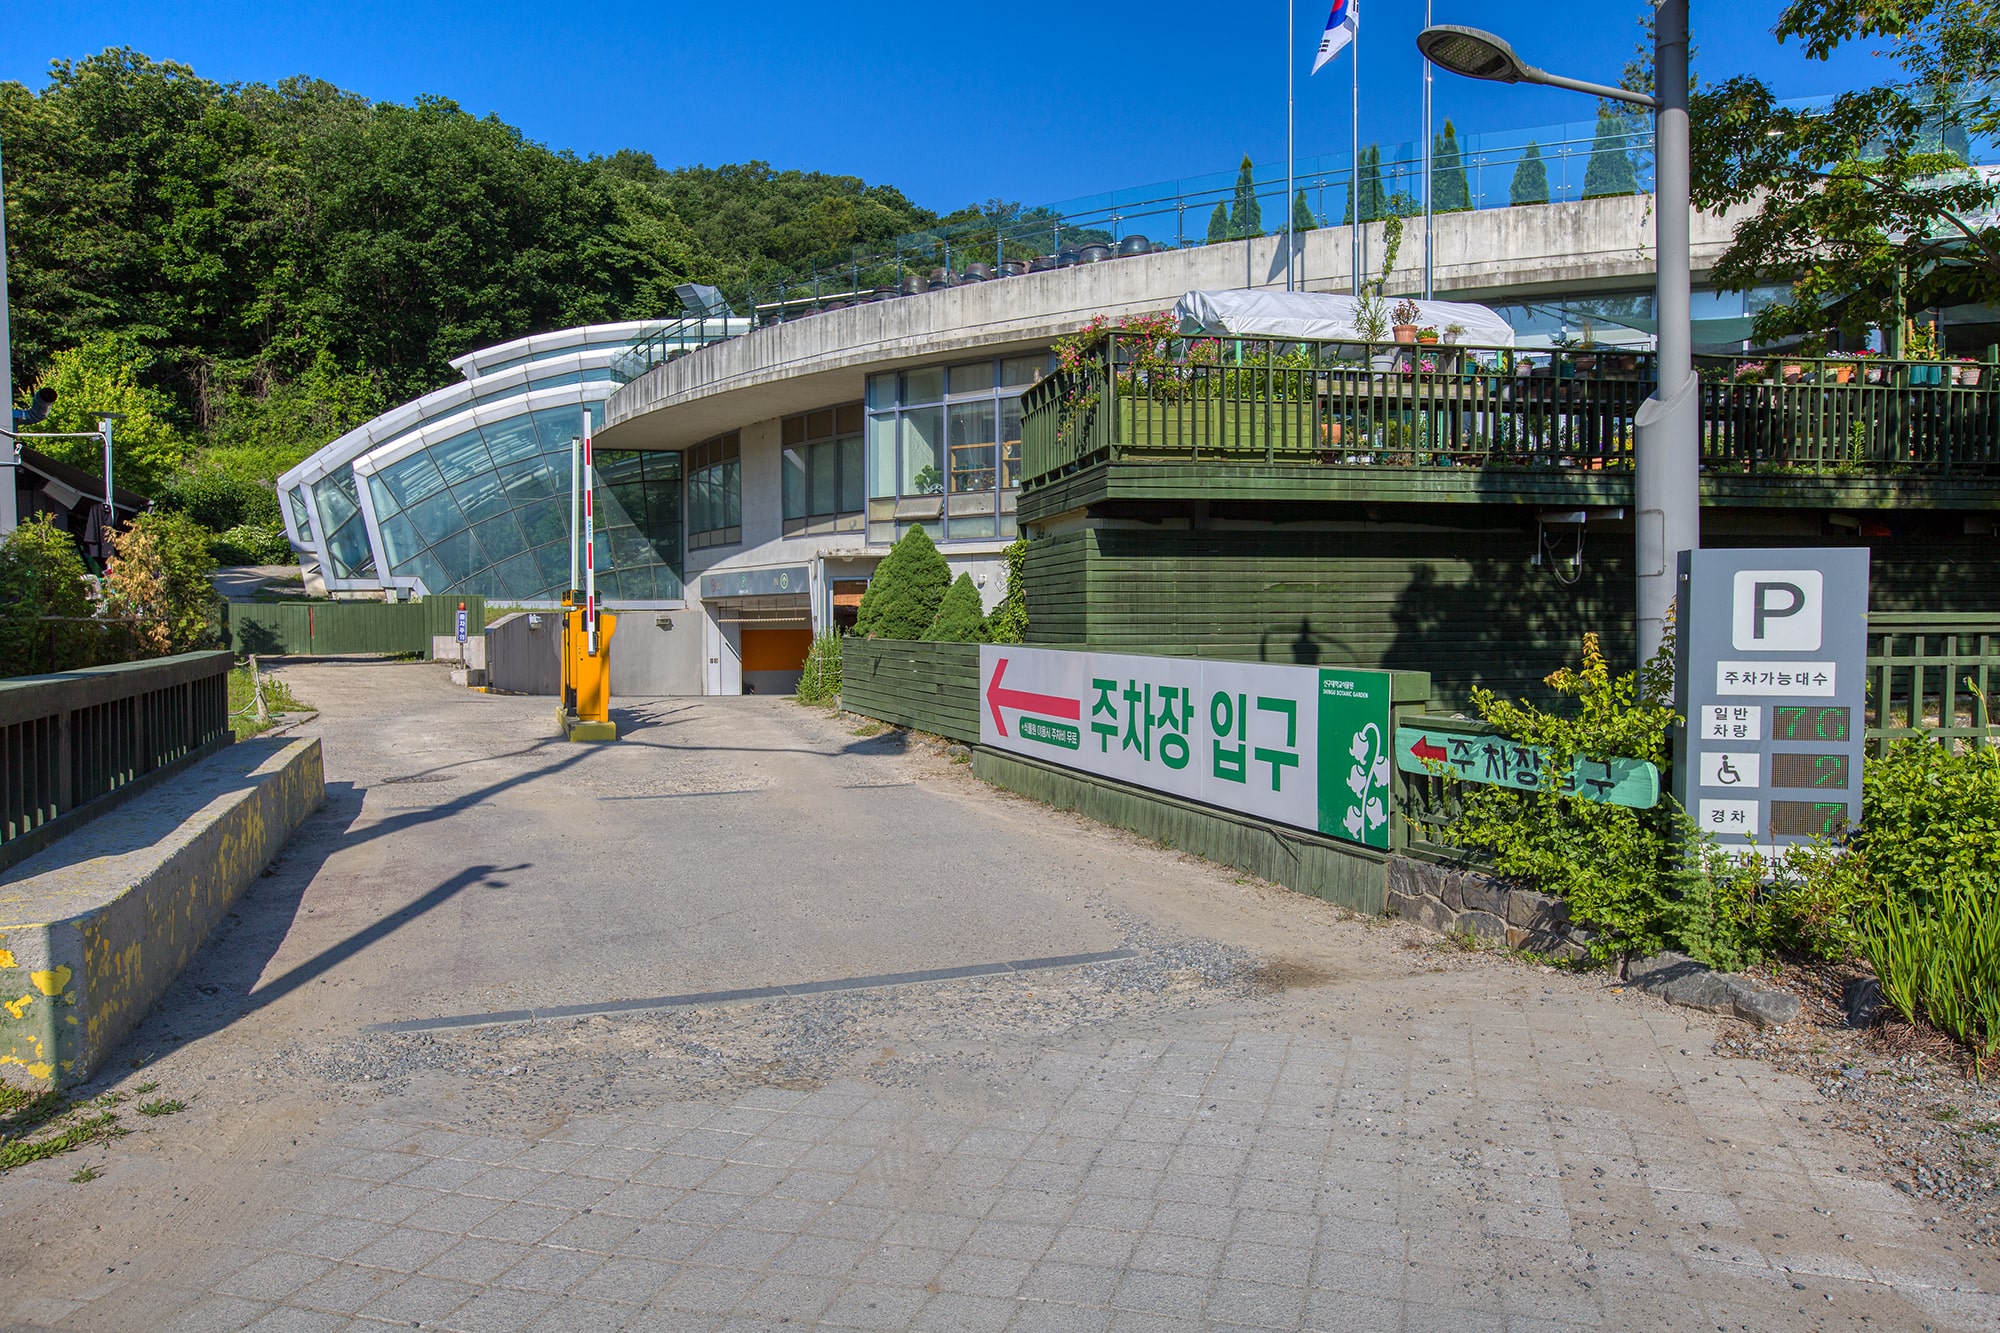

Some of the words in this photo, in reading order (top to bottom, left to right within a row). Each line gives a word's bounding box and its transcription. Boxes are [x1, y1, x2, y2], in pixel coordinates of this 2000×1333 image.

[1753, 581, 1805, 639] P
[1724, 671, 1828, 686] 주차가능대수
[1352, 691, 1369, 699] GARDEN
[1714, 707, 1748, 721] 일반
[1779, 707, 1844, 738] 76
[1091, 678, 1194, 770] 주차장
[1210, 690, 1299, 792] 입구
[1713, 724, 1748, 738] 차량
[1815, 755, 1843, 785] 2
[1711, 809, 1746, 823] 경차
[1815, 803, 1842, 833] 7
